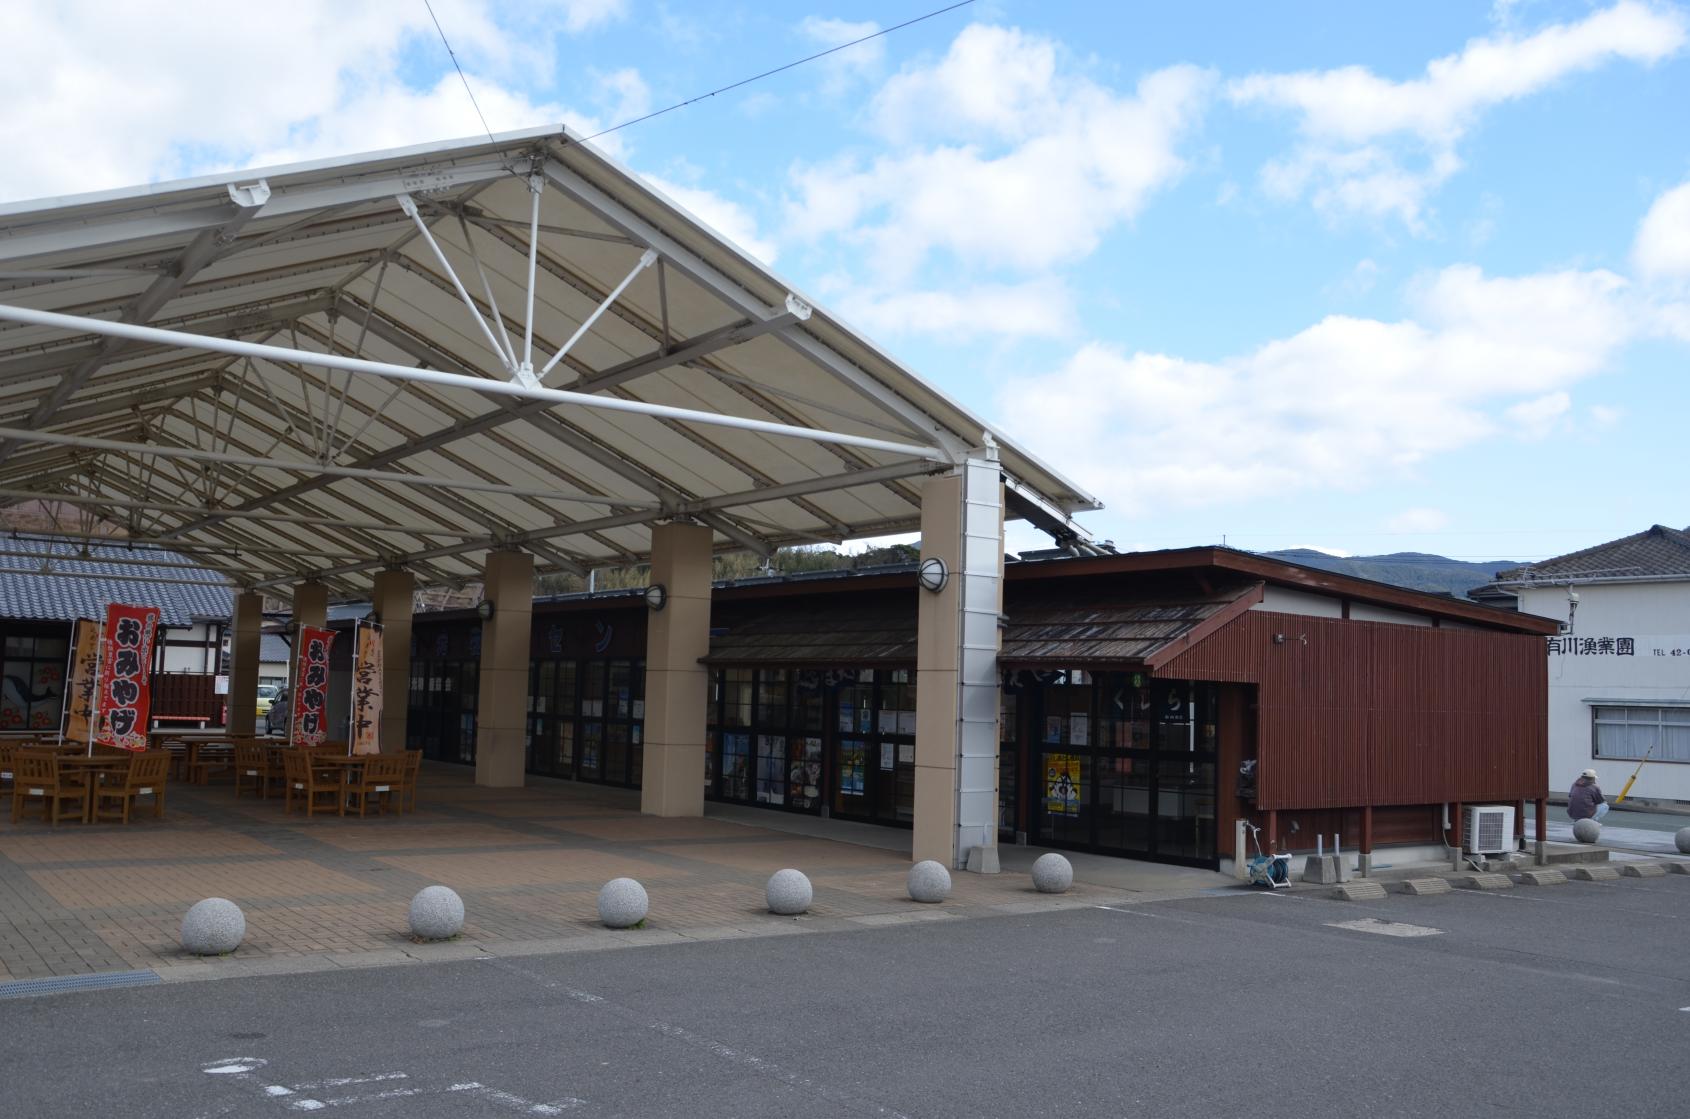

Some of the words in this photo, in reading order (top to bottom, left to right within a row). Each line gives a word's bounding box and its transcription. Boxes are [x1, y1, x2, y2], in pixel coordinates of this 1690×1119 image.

[109, 617, 142, 736] おみやげ
[301, 638, 327, 735] おみやげ
[356, 660, 380, 739] 営業中
